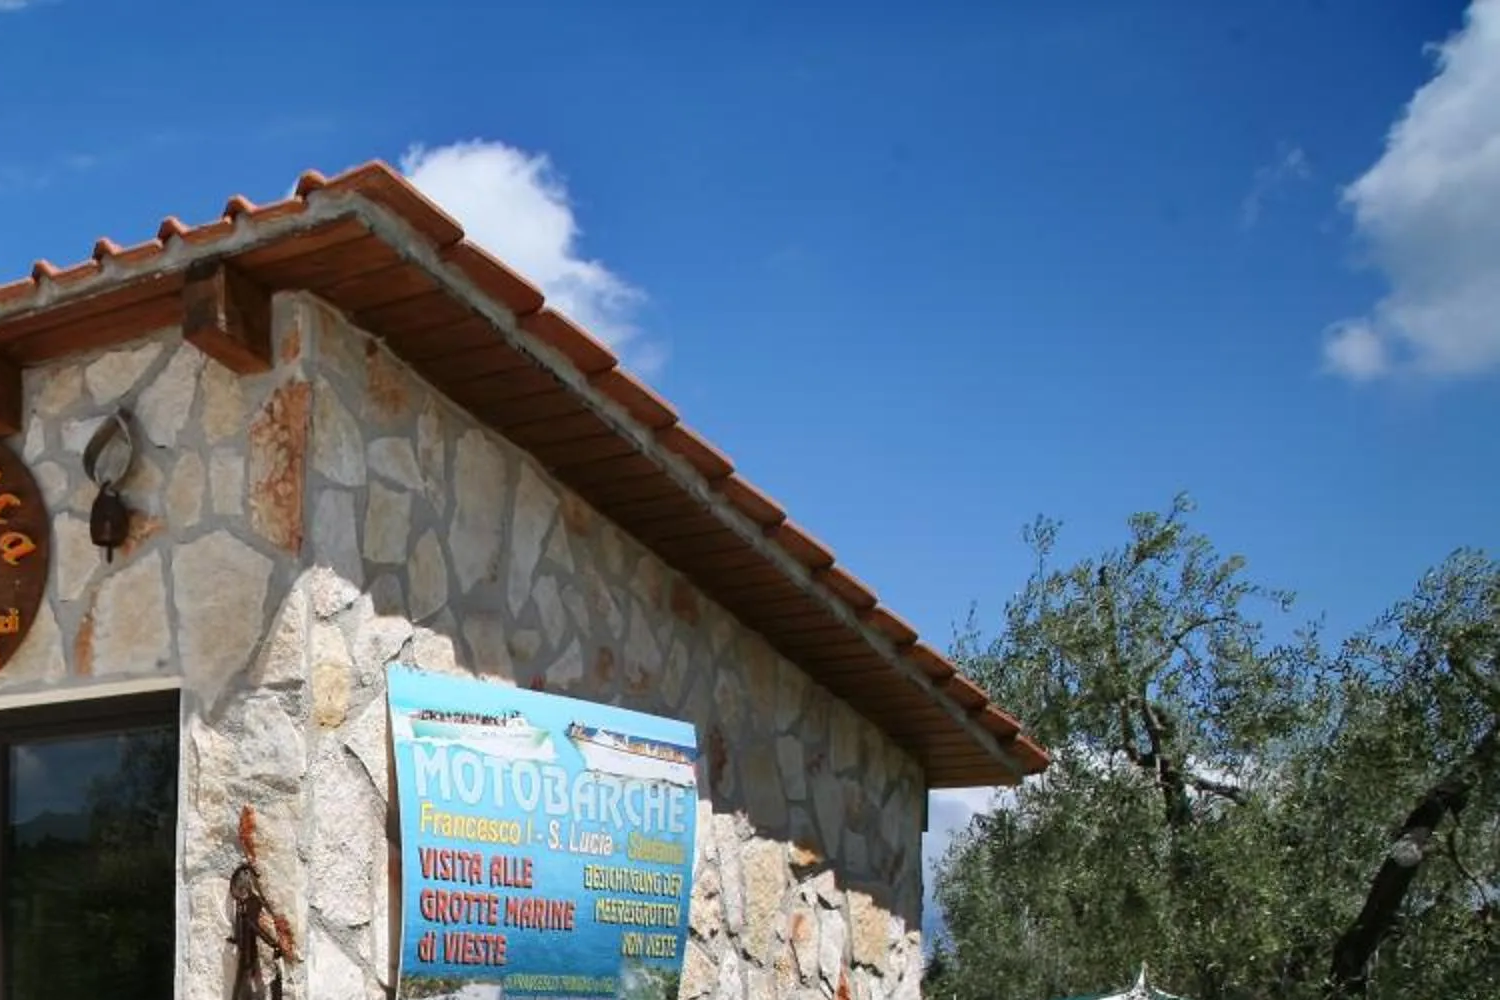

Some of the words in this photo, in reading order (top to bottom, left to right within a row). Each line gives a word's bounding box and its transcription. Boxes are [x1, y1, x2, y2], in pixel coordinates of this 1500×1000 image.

[414, 743, 689, 834] MOTOBARCHE
[420, 802, 521, 847] Francesco
[548, 820, 565, 849] S.
[568, 820, 613, 857] Lucia
[419, 848, 484, 883] VISITA
[489, 855, 534, 889] ALLE
[420, 889, 499, 926] GROTTE
[504, 897, 576, 931] MARINE
[418, 932, 437, 963] di
[442, 932, 507, 966] VIESTE
